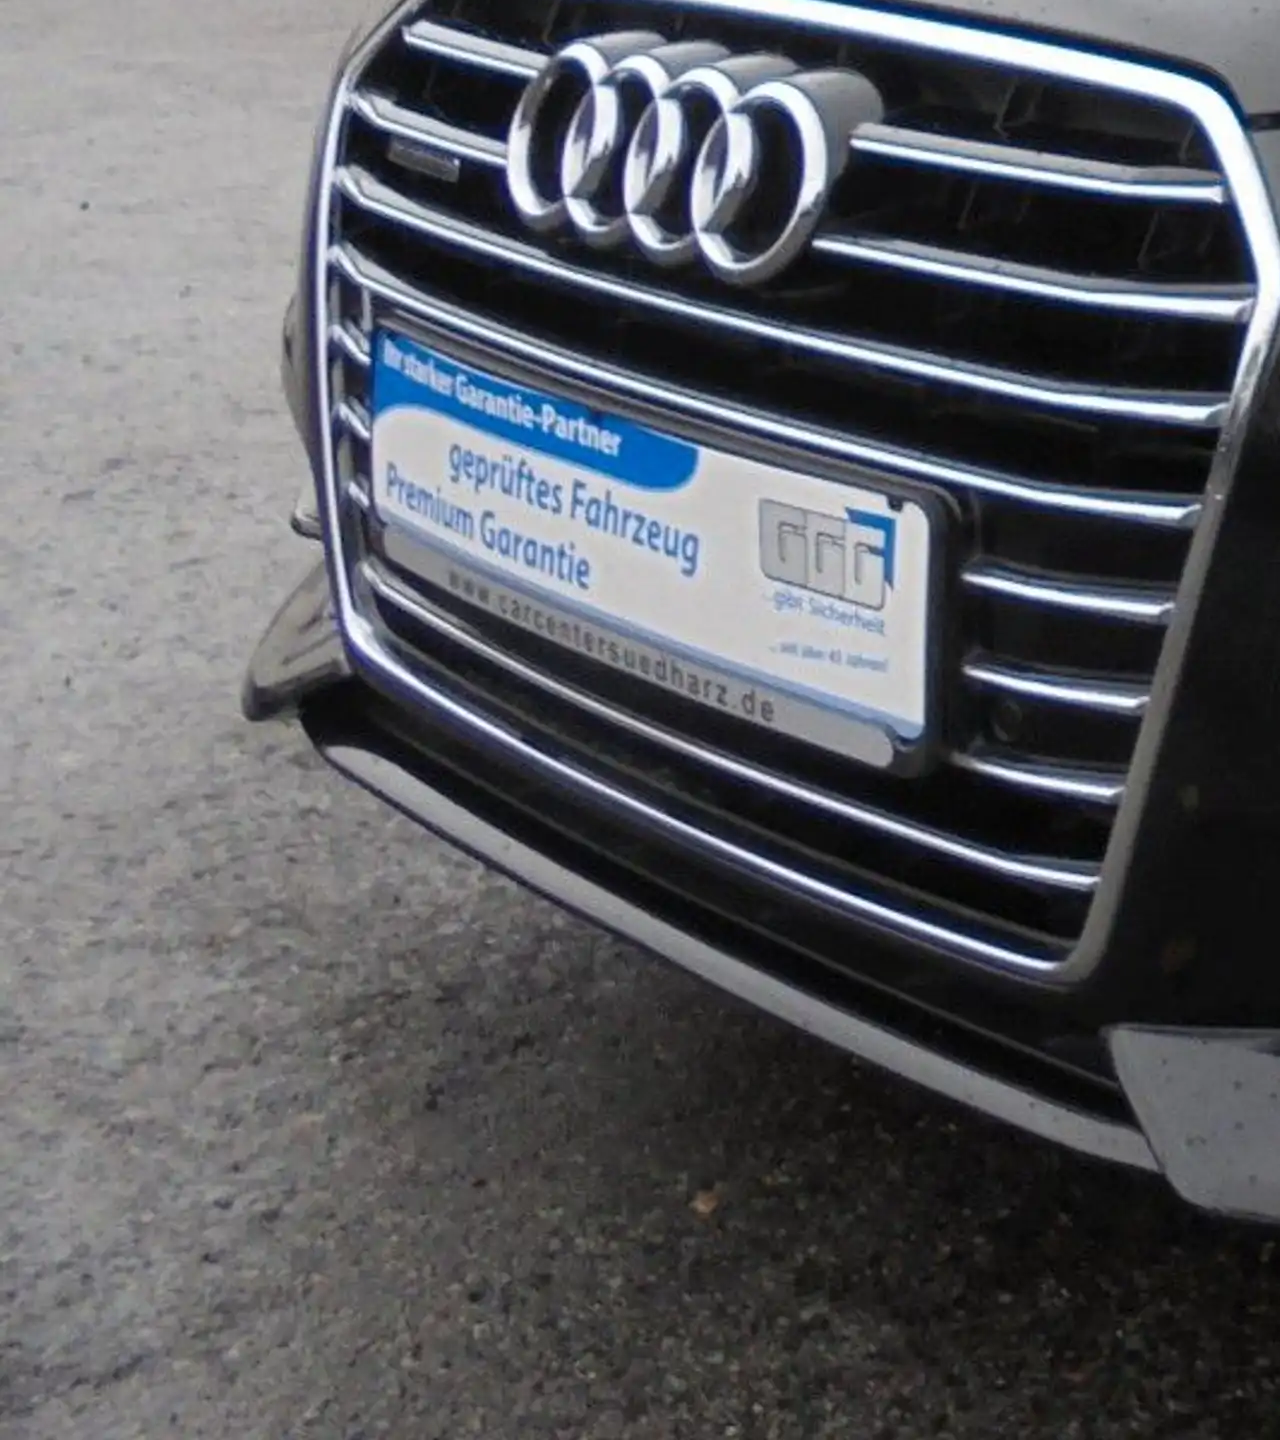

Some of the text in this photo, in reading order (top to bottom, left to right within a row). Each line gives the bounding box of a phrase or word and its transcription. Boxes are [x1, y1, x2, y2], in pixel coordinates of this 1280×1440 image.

[455, 373, 623, 457] Garantie-Partner
[386, 462, 592, 591] Premium Garantie
[449, 444, 700, 578] geprüftes Fahrzeug
